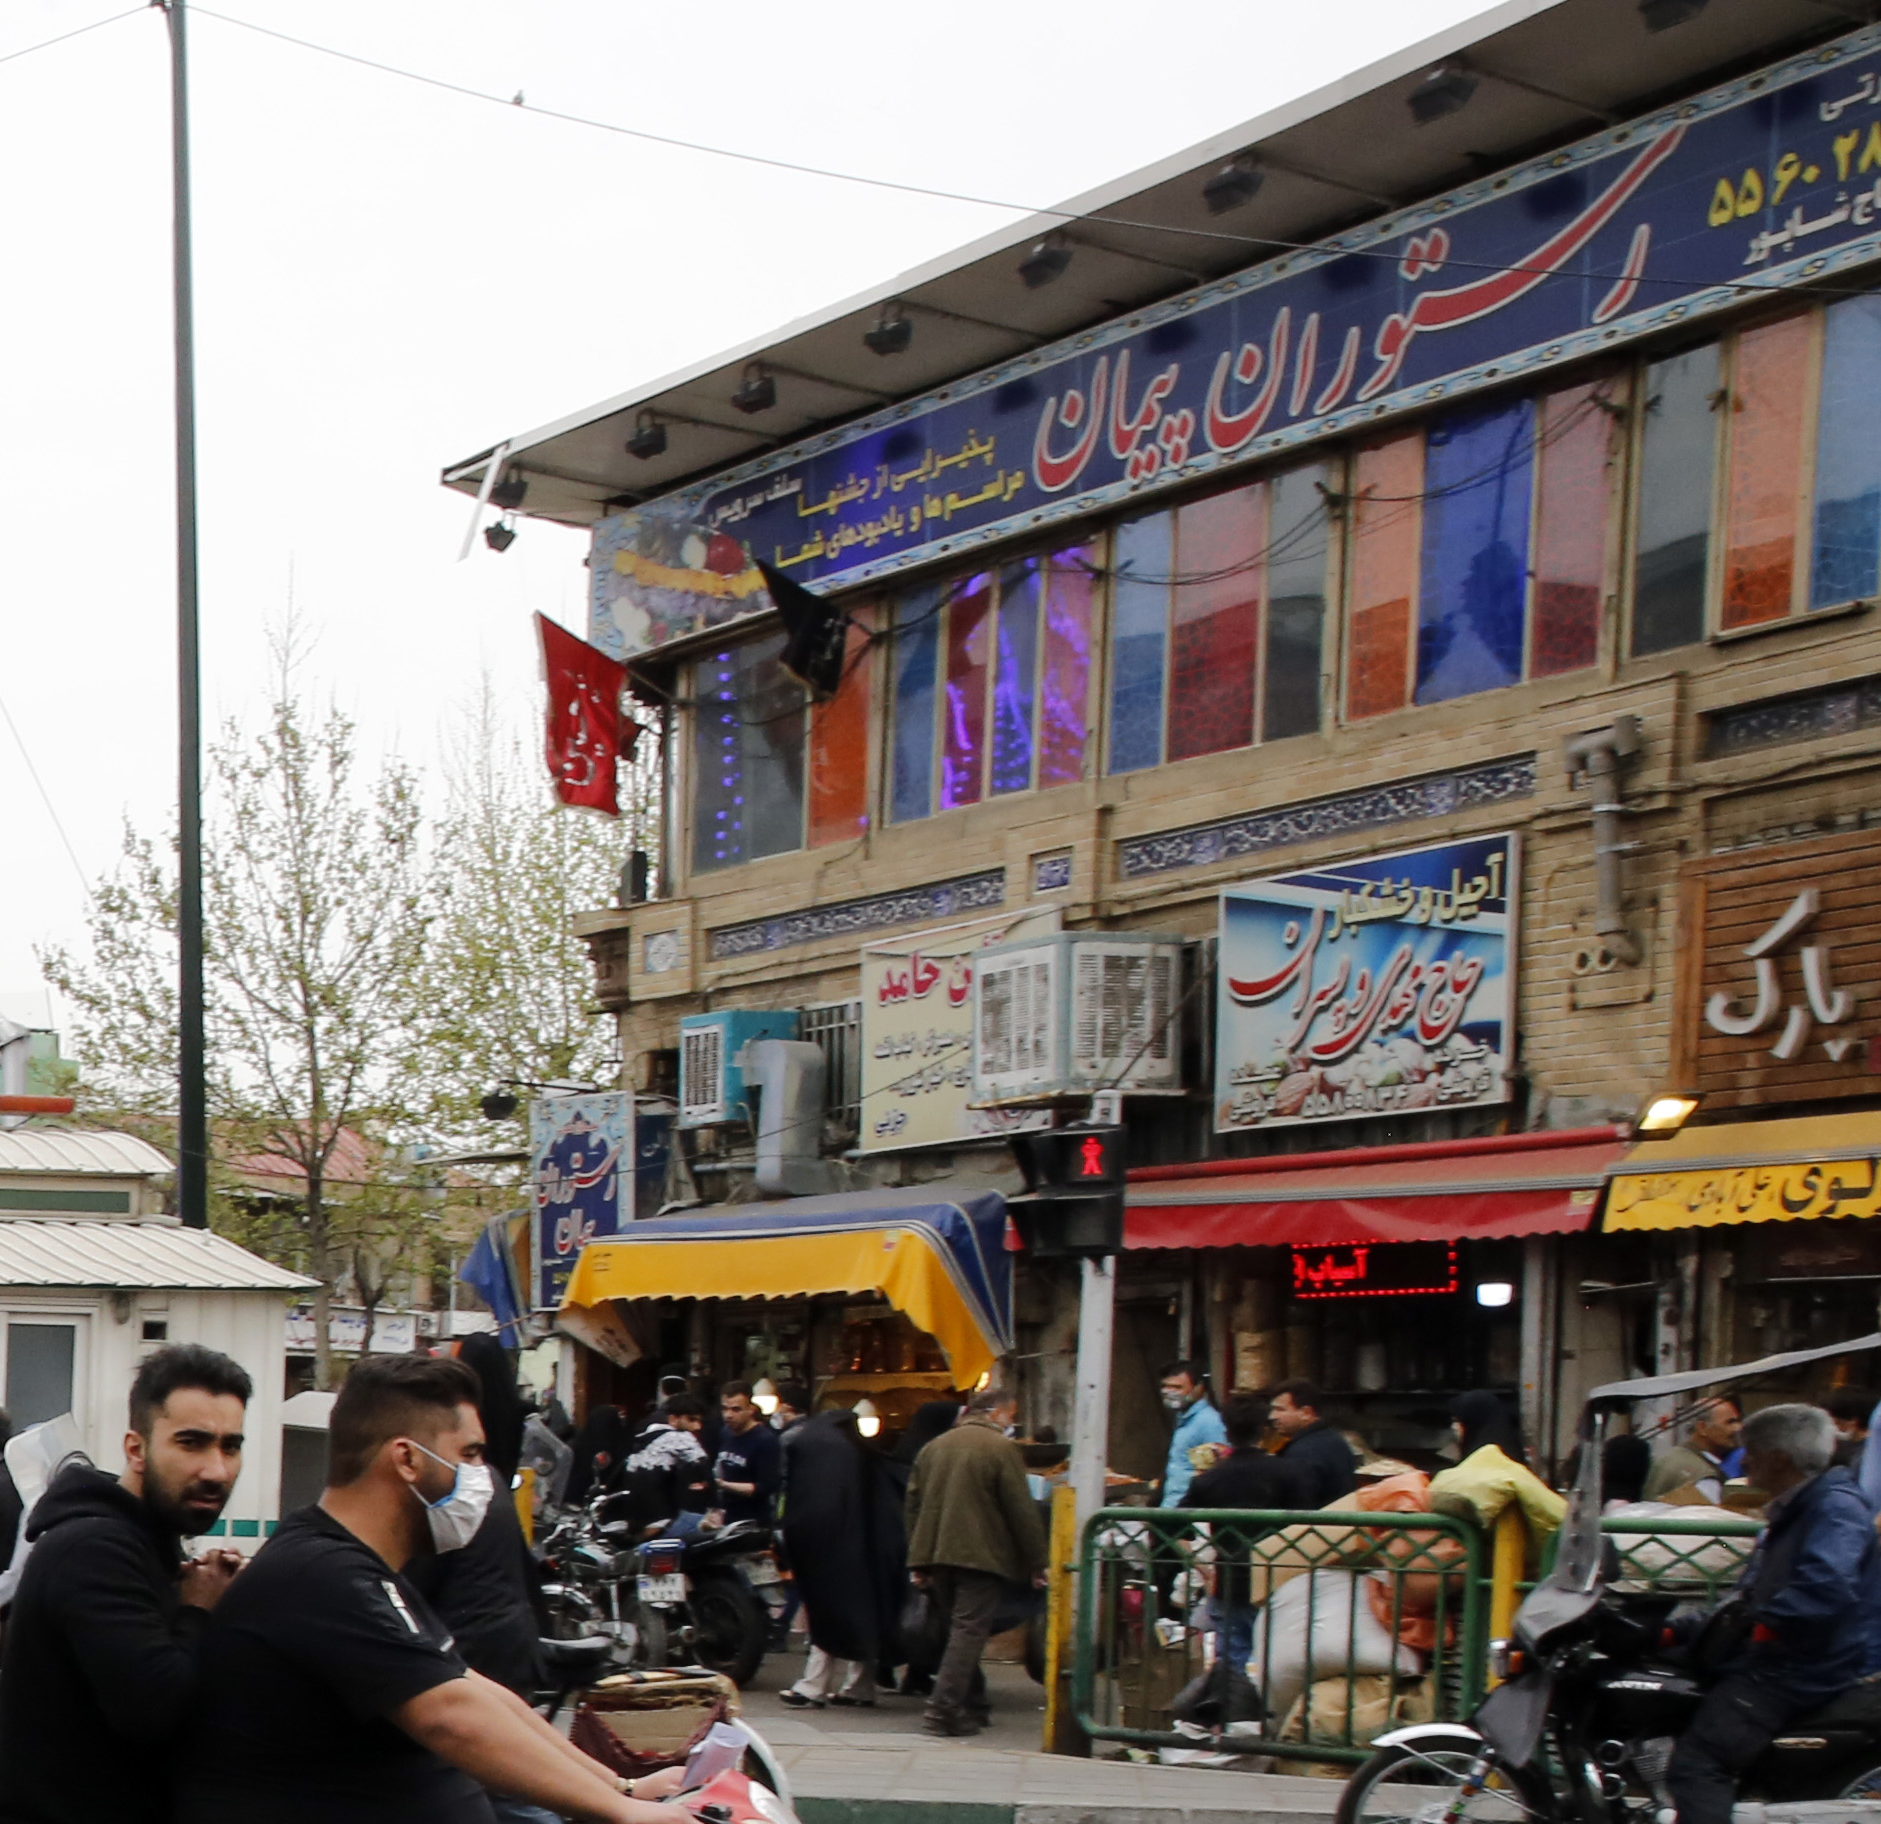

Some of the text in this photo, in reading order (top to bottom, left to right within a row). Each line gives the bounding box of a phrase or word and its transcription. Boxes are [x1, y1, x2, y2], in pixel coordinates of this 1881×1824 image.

[1035, 120, 1690, 492] رستوران پیمان
[1418, 886, 1434, 924] و
[1438, 852, 1506, 921] آجیل
[1705, 888, 1850, 1062] پارک
